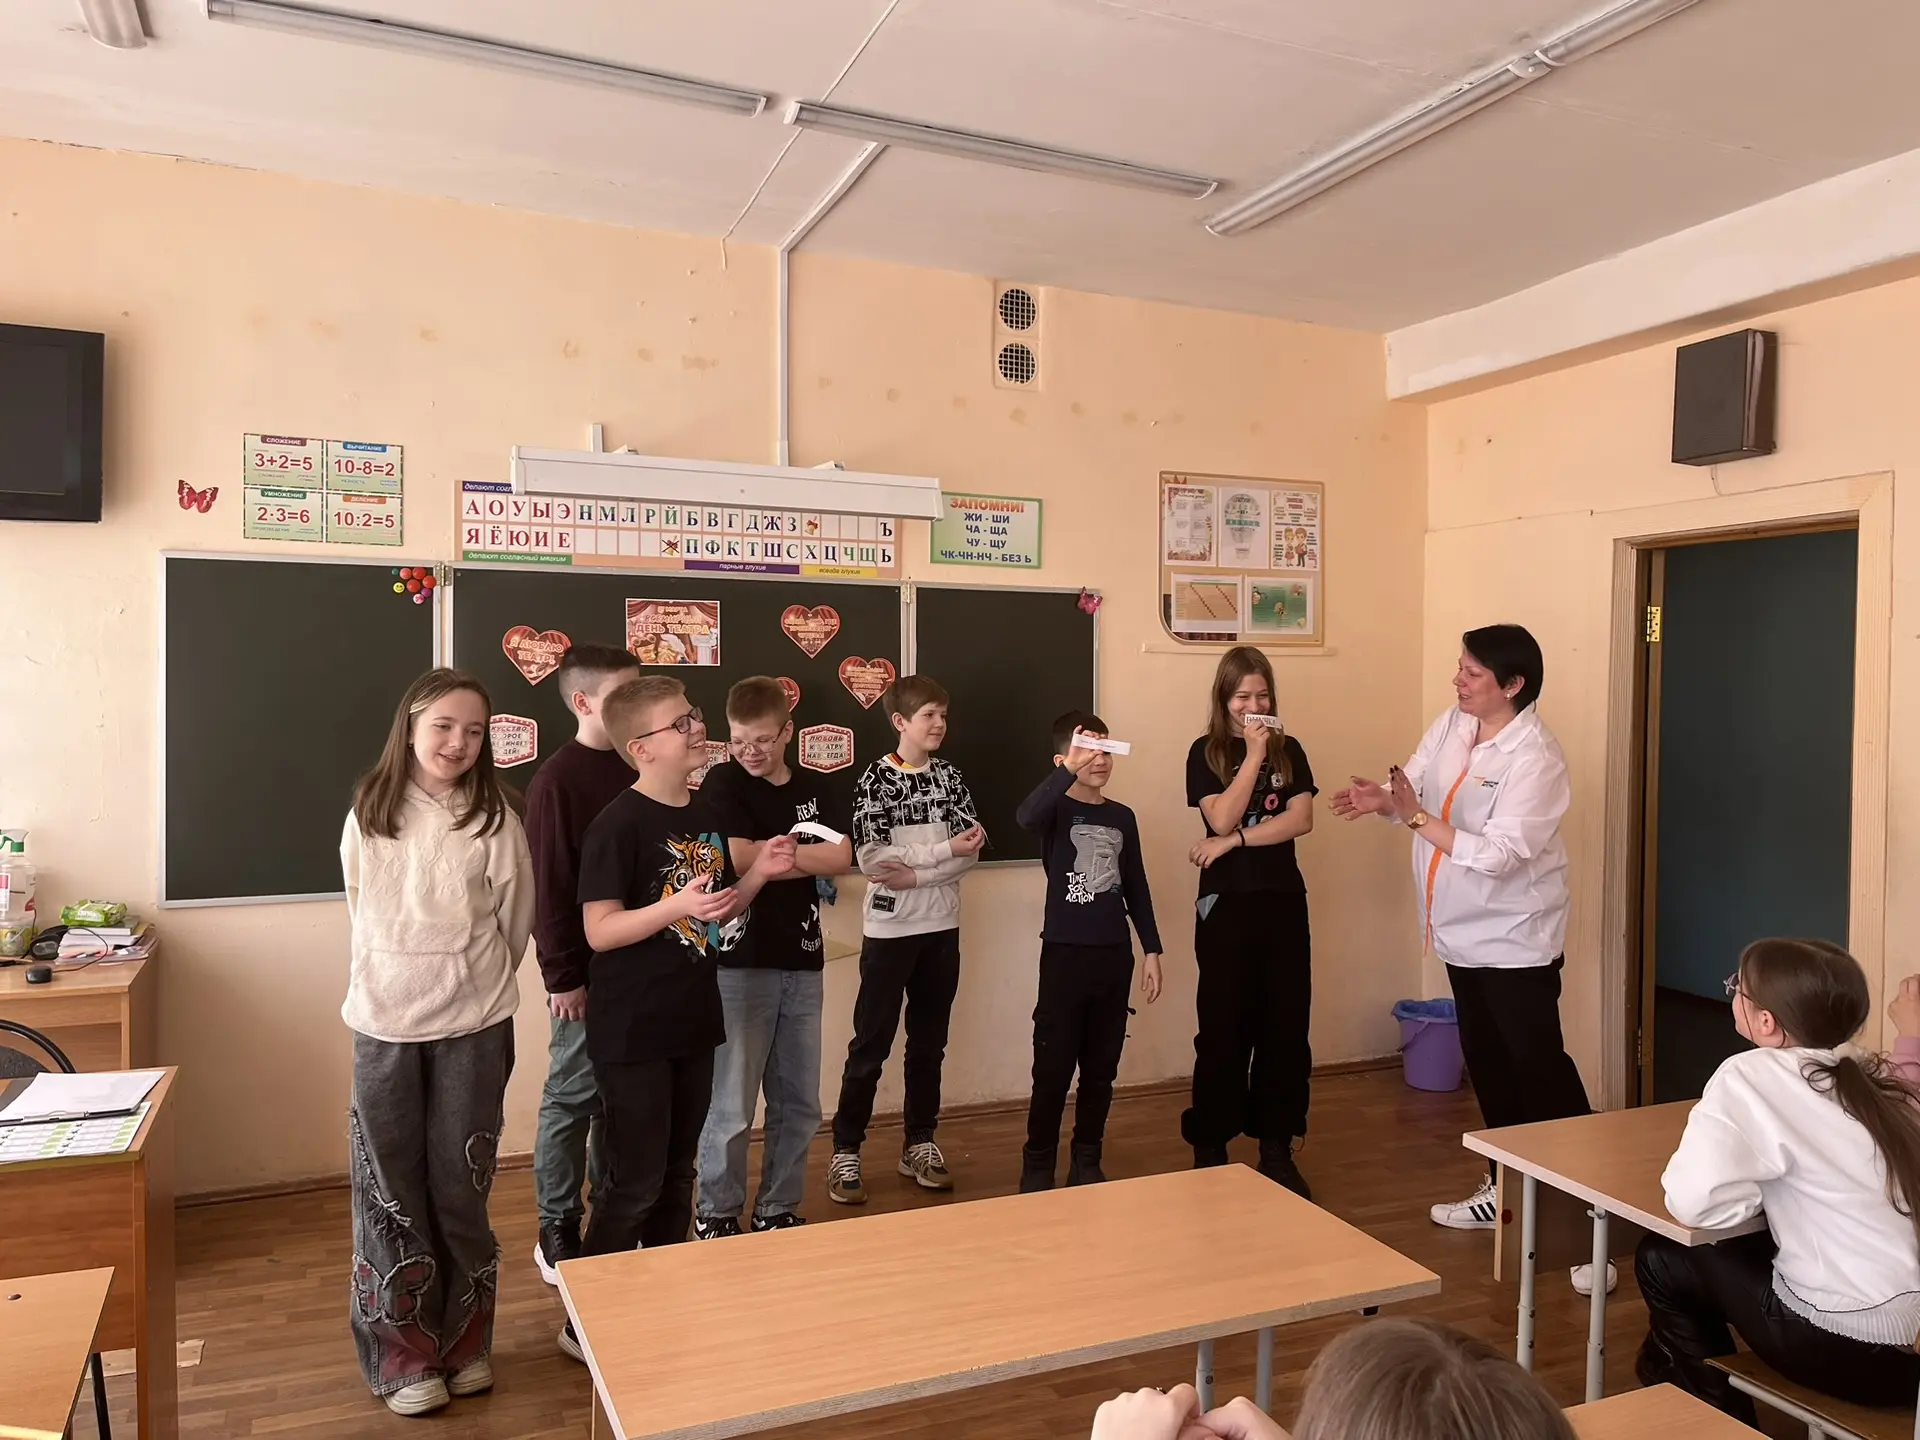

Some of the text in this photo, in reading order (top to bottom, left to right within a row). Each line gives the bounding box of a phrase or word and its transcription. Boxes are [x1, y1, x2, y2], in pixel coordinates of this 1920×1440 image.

[254, 453, 313, 471] 3+2=5
[334, 459, 395, 477] 10-8=2
[263, 491, 304, 499] УМНОЖЕНИЕ
[950, 498, 1024, 513] ЗАПОМНИ!
[333, 511, 395, 528] 10:2=5
[466, 499, 893, 537] А О У Ы Э Н М Л Р Й Б В Г Д Ж З Ъ
[964, 512, 982, 522] ЖИ
[992, 515, 1010, 524] ШИ
[965, 524, 980, 534] ЧА
[990, 526, 1008, 536] ЩА
[466, 525, 891, 565] Я Ё Ю И Е П Ф К Т Ш С Х Ц Ч Щ Ь
[966, 538, 980, 547] ЧУ
[990, 539, 1007, 550] ЩУ
[468, 552, 566, 563] делают согласный мягким
[940, 550, 992, 561] ЧК-ЧН-НЧ
[1001, 554, 1021, 563] БЕЗ
[1025, 555, 1032, 563] Ь
[719, 563, 767, 572] парные глухие
[819, 567, 840, 575] всегда
[635, 623, 710, 634] ДЕНЬ ТЕАТРА
[510, 637, 565, 653] Я ЛЮБЛЮ
[517, 650, 556, 665] ТЕАТР!
[1065, 872, 1087, 885] TIME
[1067, 882, 1086, 894] FOR
[1065, 891, 1096, 905] ACTION
